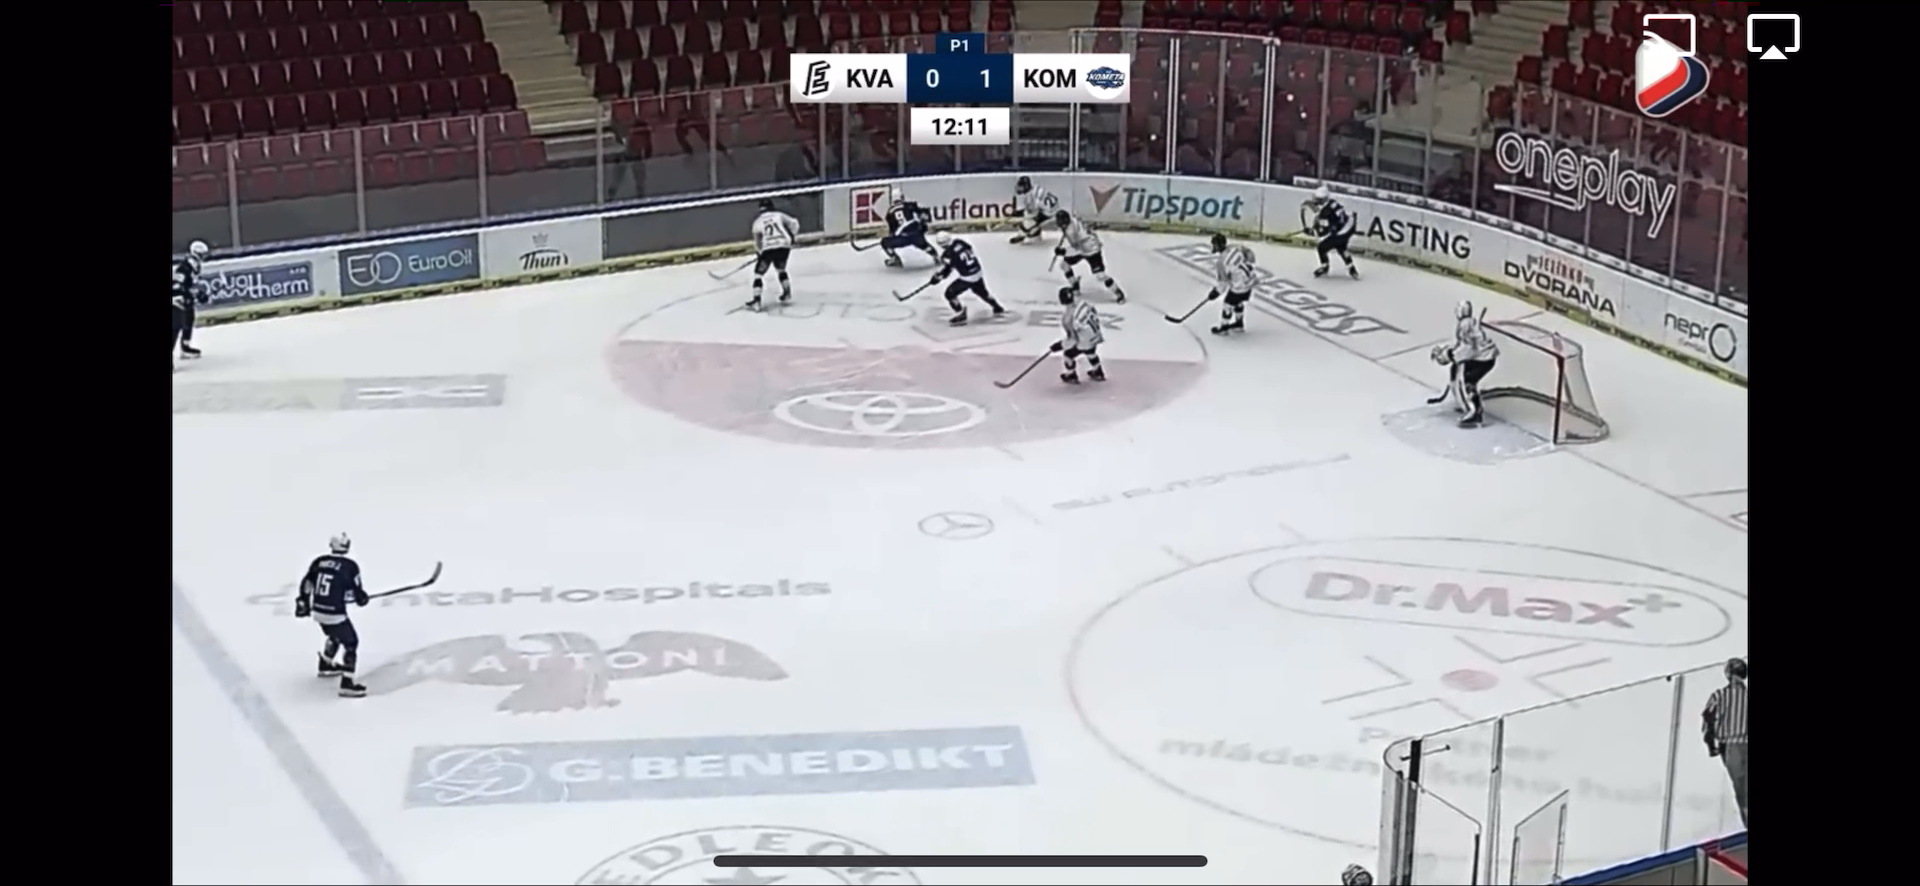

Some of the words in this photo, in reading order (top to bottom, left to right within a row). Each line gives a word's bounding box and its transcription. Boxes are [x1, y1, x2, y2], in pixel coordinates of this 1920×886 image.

[1497, 131, 1676, 239] oneplay
[926, 197, 1017, 223] ufland
[1121, 186, 1244, 223] Tipsport
[1352, 212, 1471, 260] LASTING
[1504, 260, 1616, 318] DVORANA
[315, 572, 334, 596] 15
[380, 578, 833, 609] ntaHospitals
[405, 647, 729, 676] MATTONI
[549, 743, 1015, 784] G.BENEDIKT
